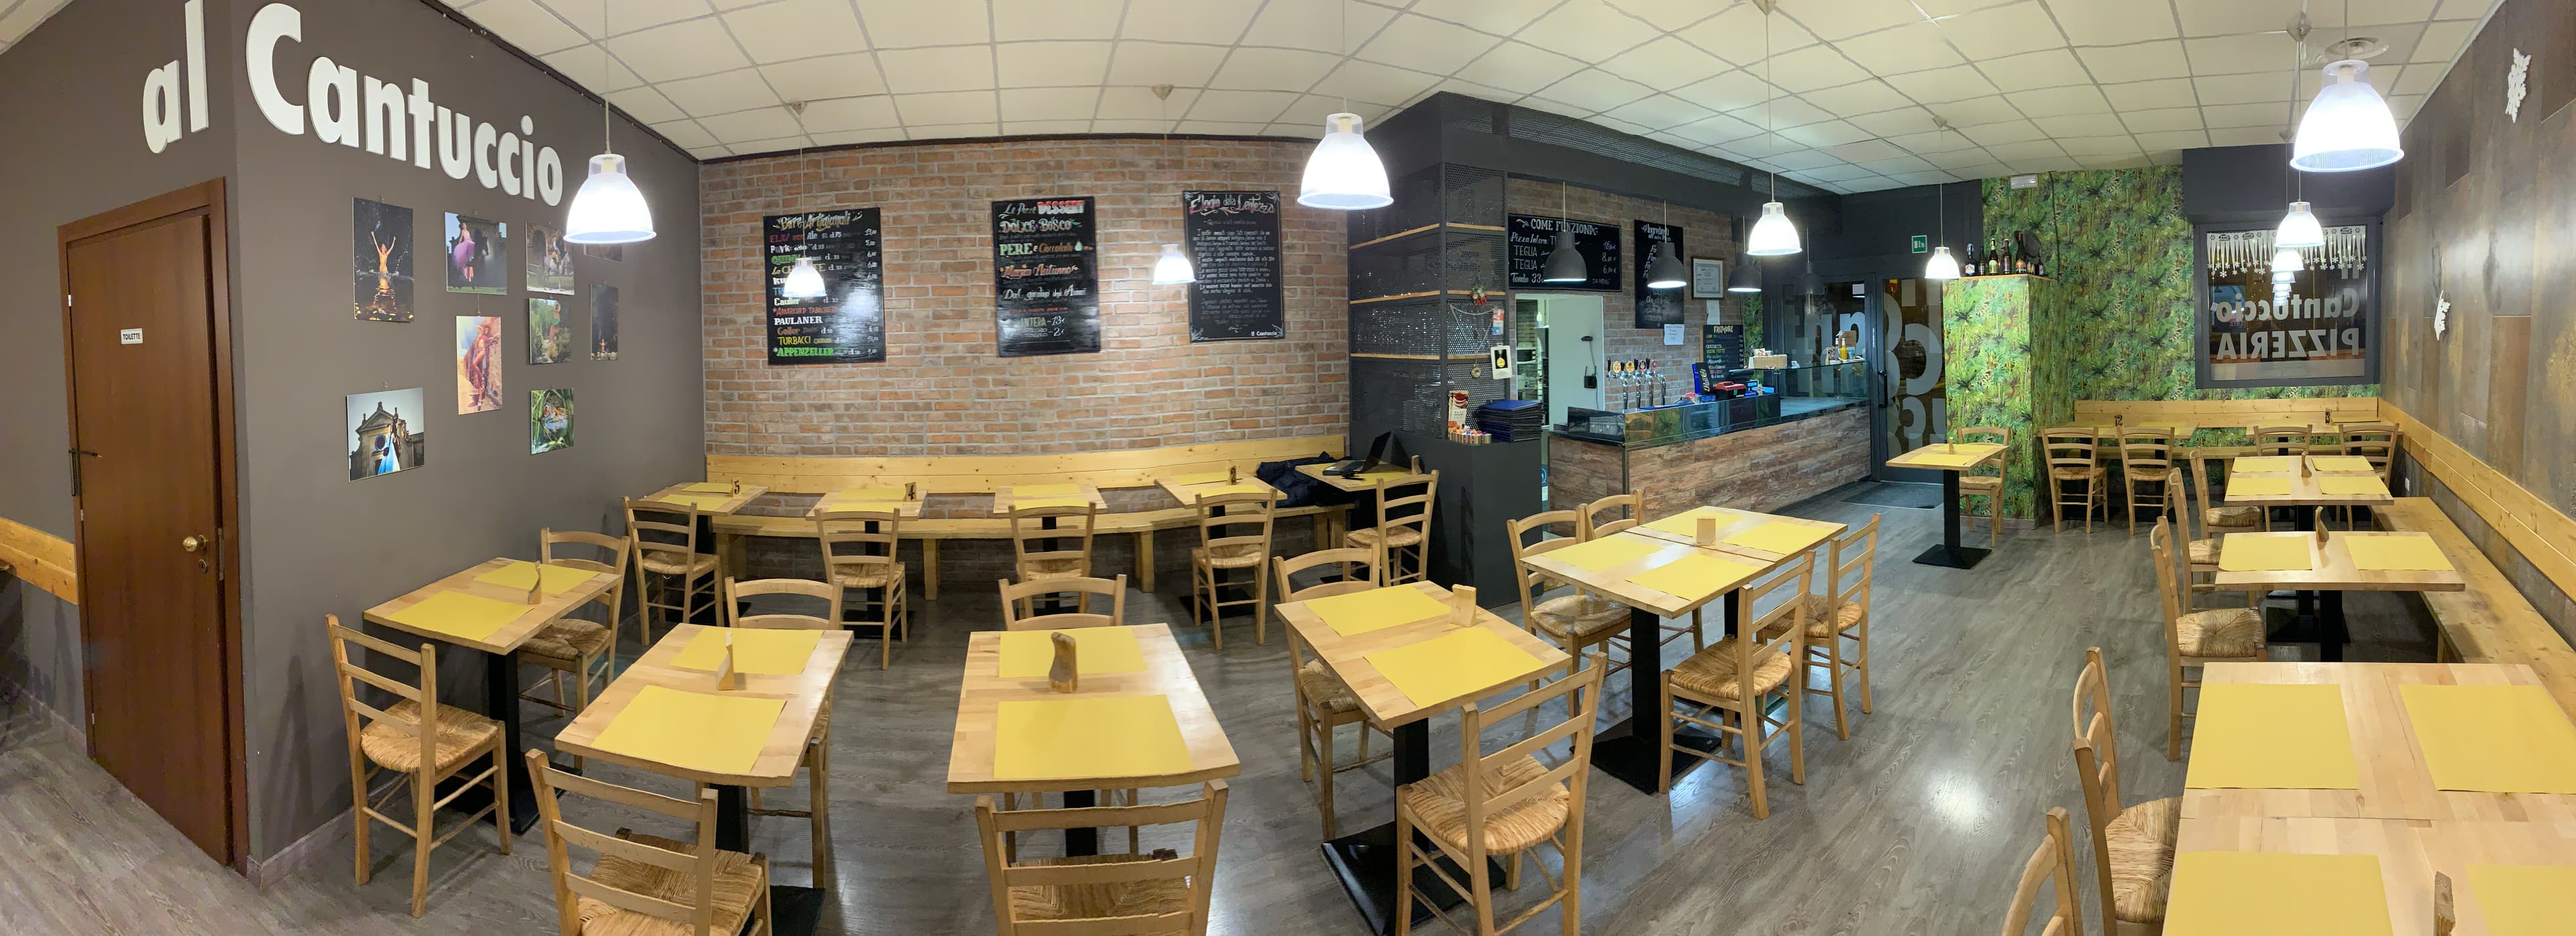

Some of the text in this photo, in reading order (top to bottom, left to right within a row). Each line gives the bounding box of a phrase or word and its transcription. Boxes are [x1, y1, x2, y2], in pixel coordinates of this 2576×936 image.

[143, 0, 563, 206] al Cantuccio
[1037, 200, 1085, 215] DESSERT
[1530, 219, 1554, 230] COME
[806, 230, 818, 240] Ale
[1510, 231, 1530, 243] Pizza
[1000, 243, 1033, 256] PERE
[1514, 245, 1538, 256] TEGLIA
[1513, 258, 1538, 270] TEGLIA
[1511, 272, 1530, 283] Tonda
[773, 316, 823, 325] PAULANER
[777, 335, 811, 346] TURBACCI
[776, 347, 835, 357] APPENZELLER
[2114, 414, 2123, 427] 12
[734, 480, 740, 495] 5
[908, 484, 914, 501] 4
